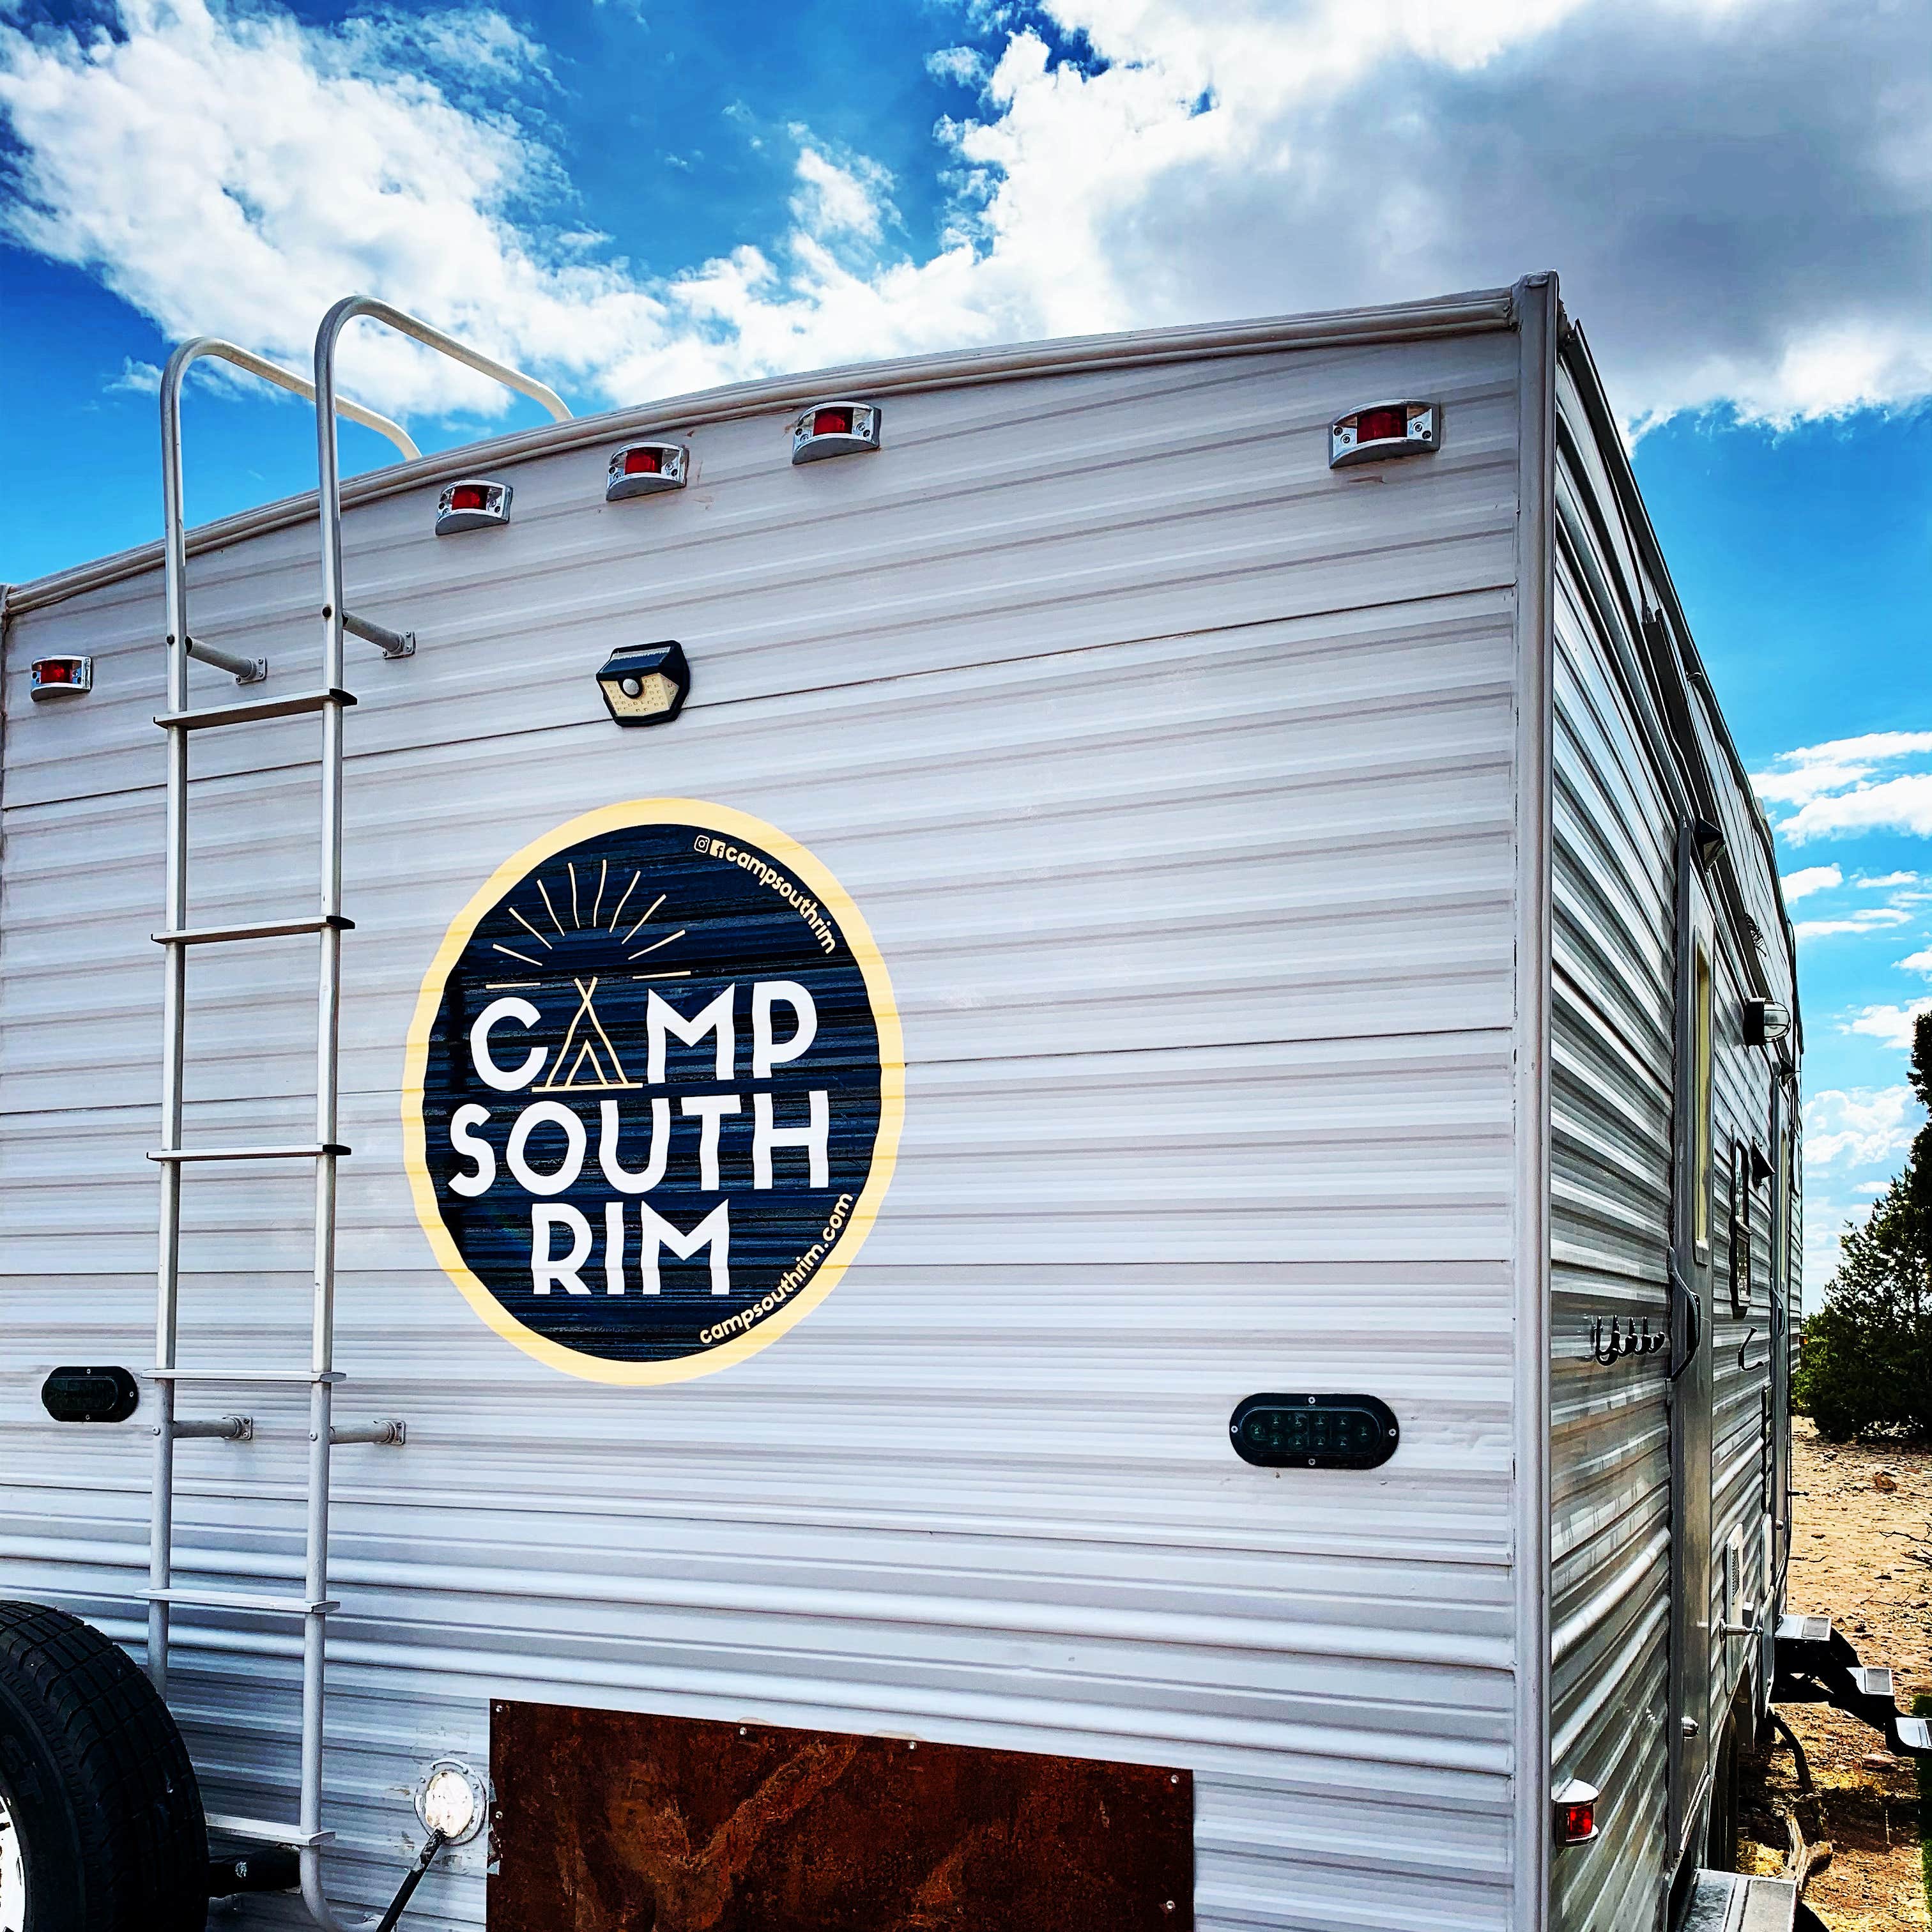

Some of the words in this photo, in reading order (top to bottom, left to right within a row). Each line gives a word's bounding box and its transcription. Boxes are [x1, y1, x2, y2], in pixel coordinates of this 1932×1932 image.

[726, 847, 836, 954] campsouthrim
[470, 977, 818, 1092] CAMP
[448, 1090, 829, 1197] SOUTH
[531, 1199, 730, 1295] RIM
[700, 1193, 854, 1344] campsouthrim.com
